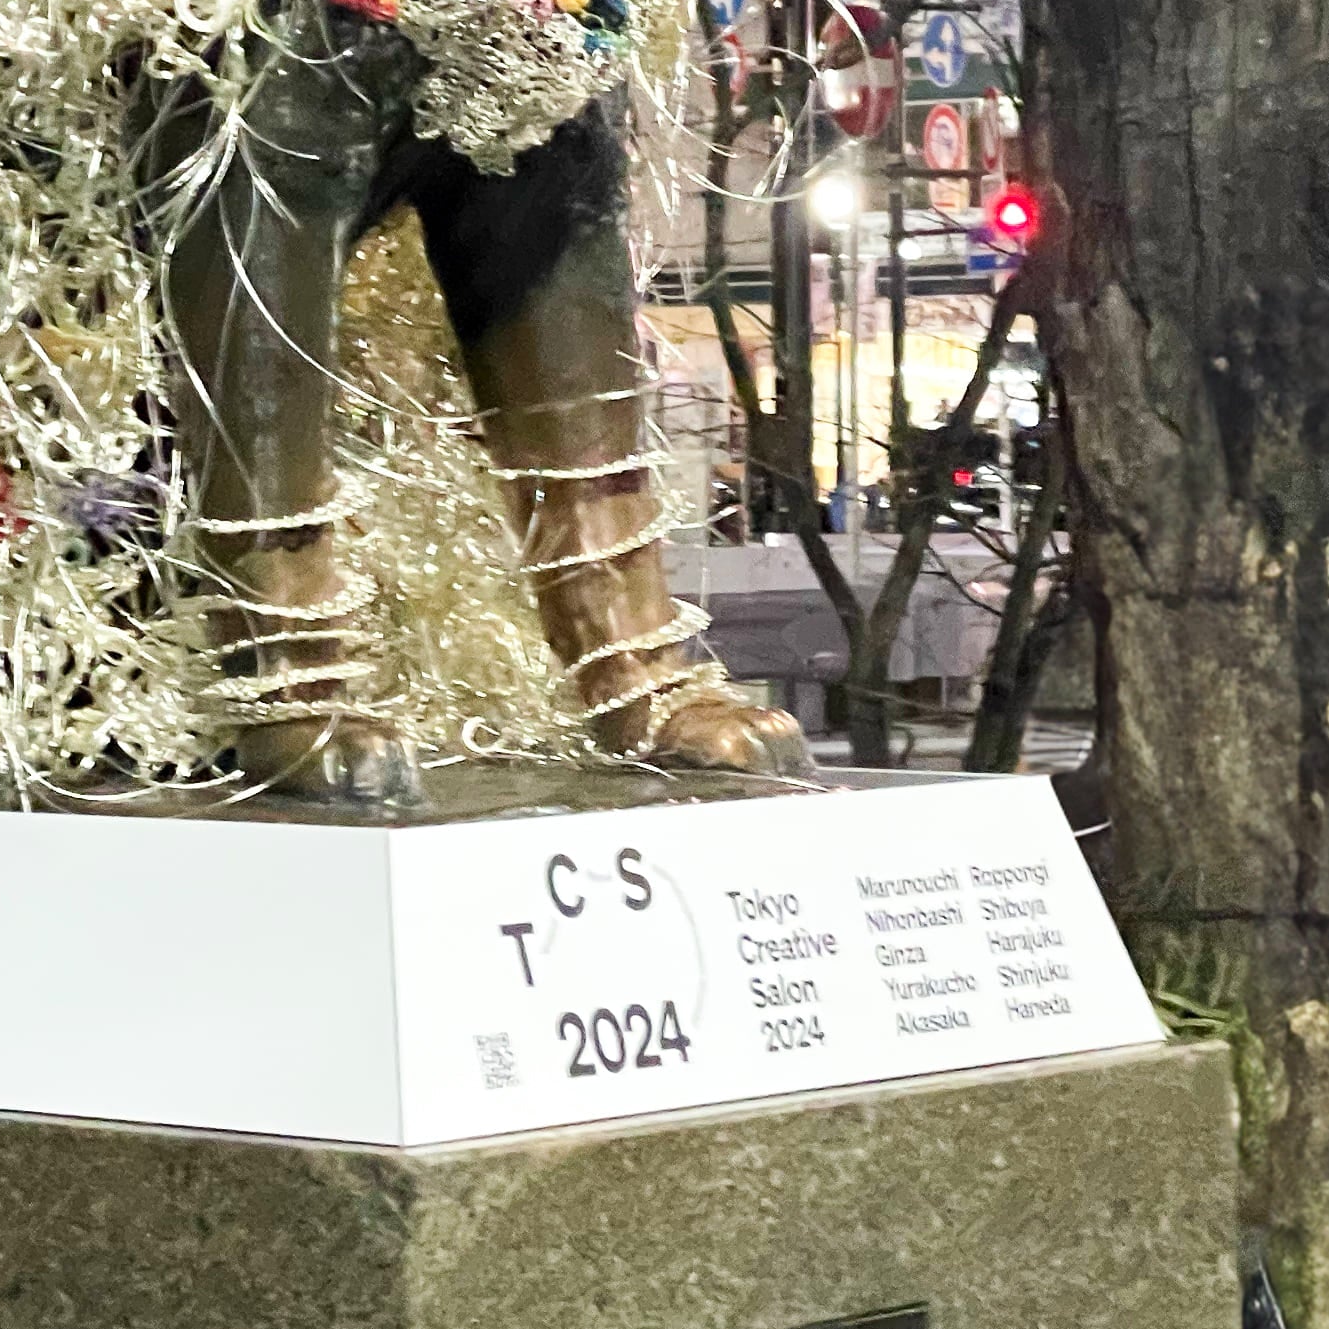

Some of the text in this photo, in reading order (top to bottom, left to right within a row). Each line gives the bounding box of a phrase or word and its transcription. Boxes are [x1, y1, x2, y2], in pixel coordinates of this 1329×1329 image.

[724, 888, 801, 924] Tokyo
[979, 897, 1048, 922] Shibuya
[737, 928, 839, 966] Creative
[875, 944, 927, 967] Ginza
[986, 925, 1064, 955] Harajuku
[997, 959, 1073, 989] Shinjuku
[748, 974, 820, 1009] Salon
[1005, 994, 1073, 1023] Haneda
[556, 999, 691, 1077] 2024
[761, 1015, 825, 1053] 2024
